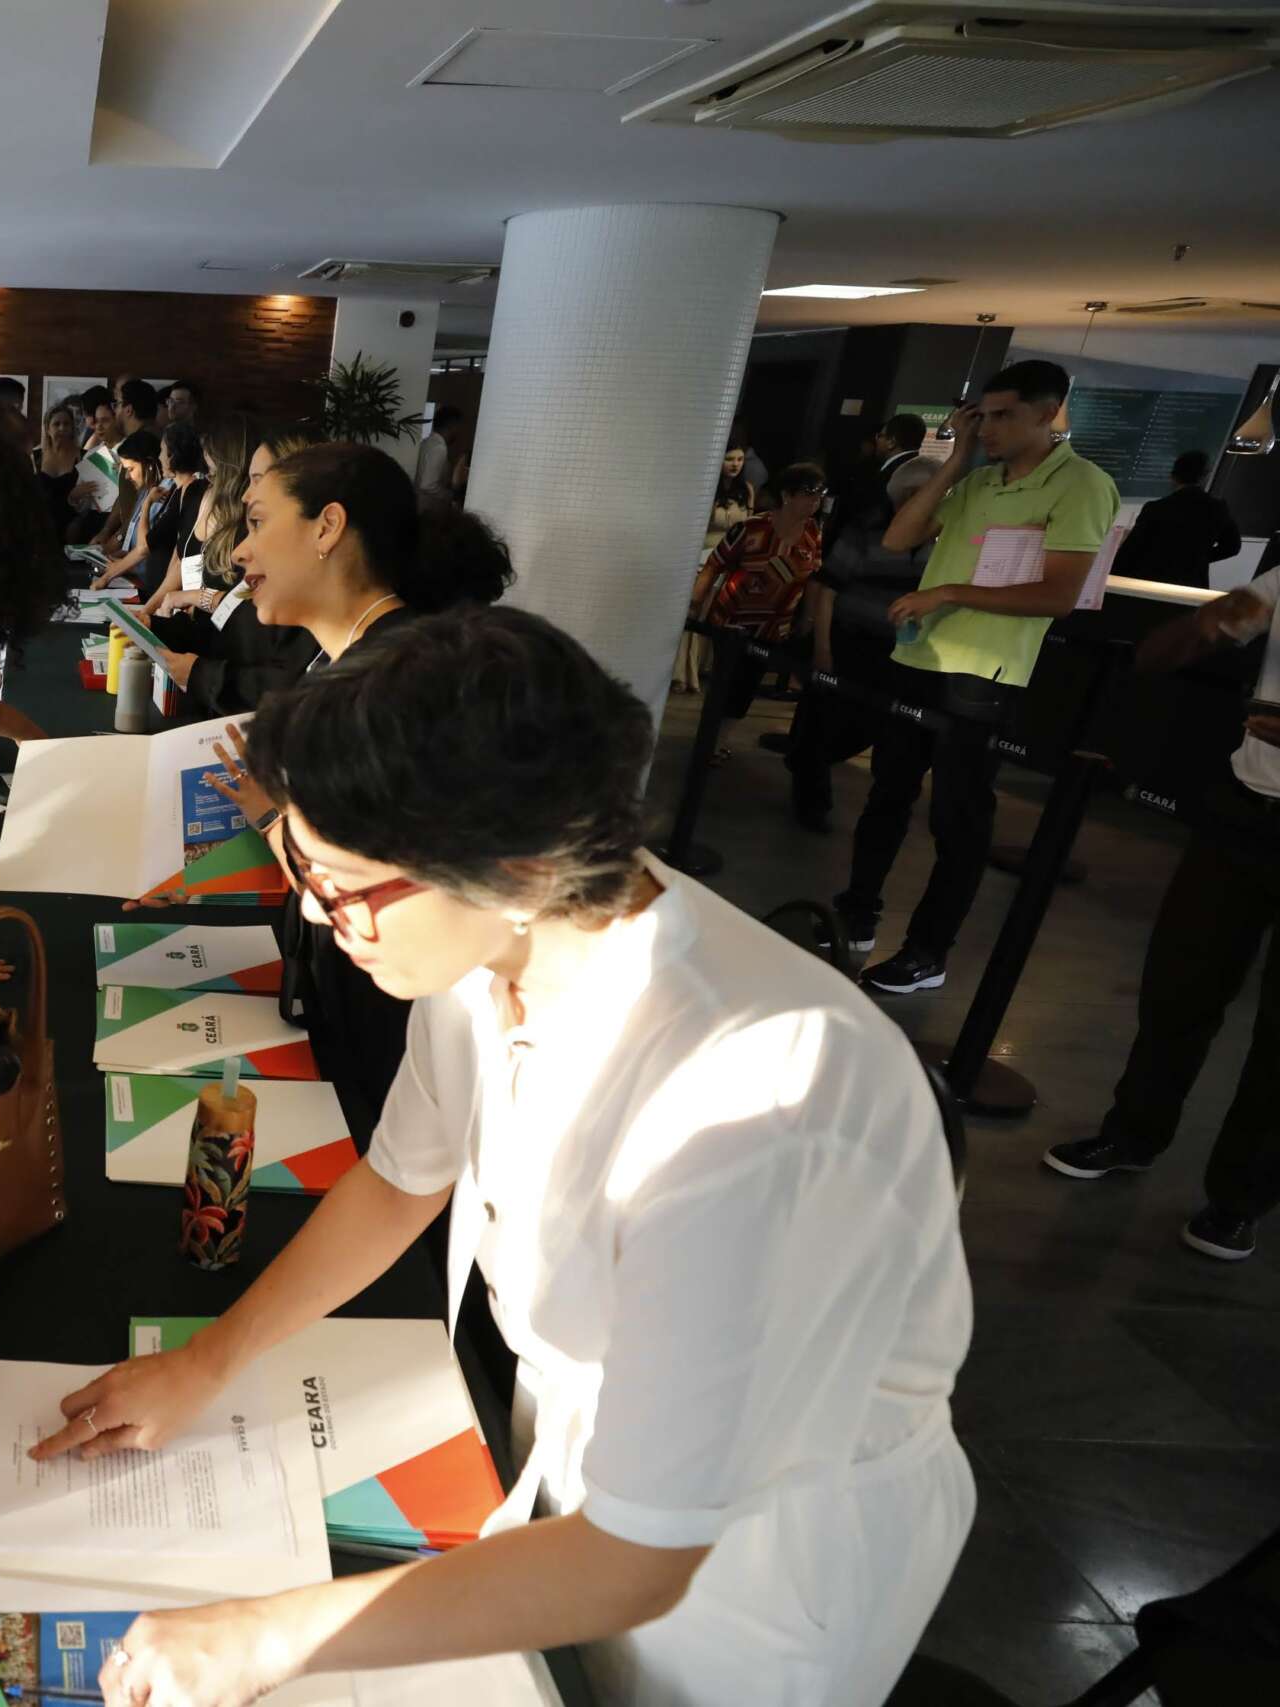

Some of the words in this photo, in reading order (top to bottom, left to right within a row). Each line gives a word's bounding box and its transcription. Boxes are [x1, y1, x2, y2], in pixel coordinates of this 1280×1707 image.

[998, 740, 1026, 757] CEARÁ
[1140, 790, 1177, 811] CEARÁ
[186, 944, 203, 968] CEARÁ
[200, 1015, 217, 1044] CEARÁ
